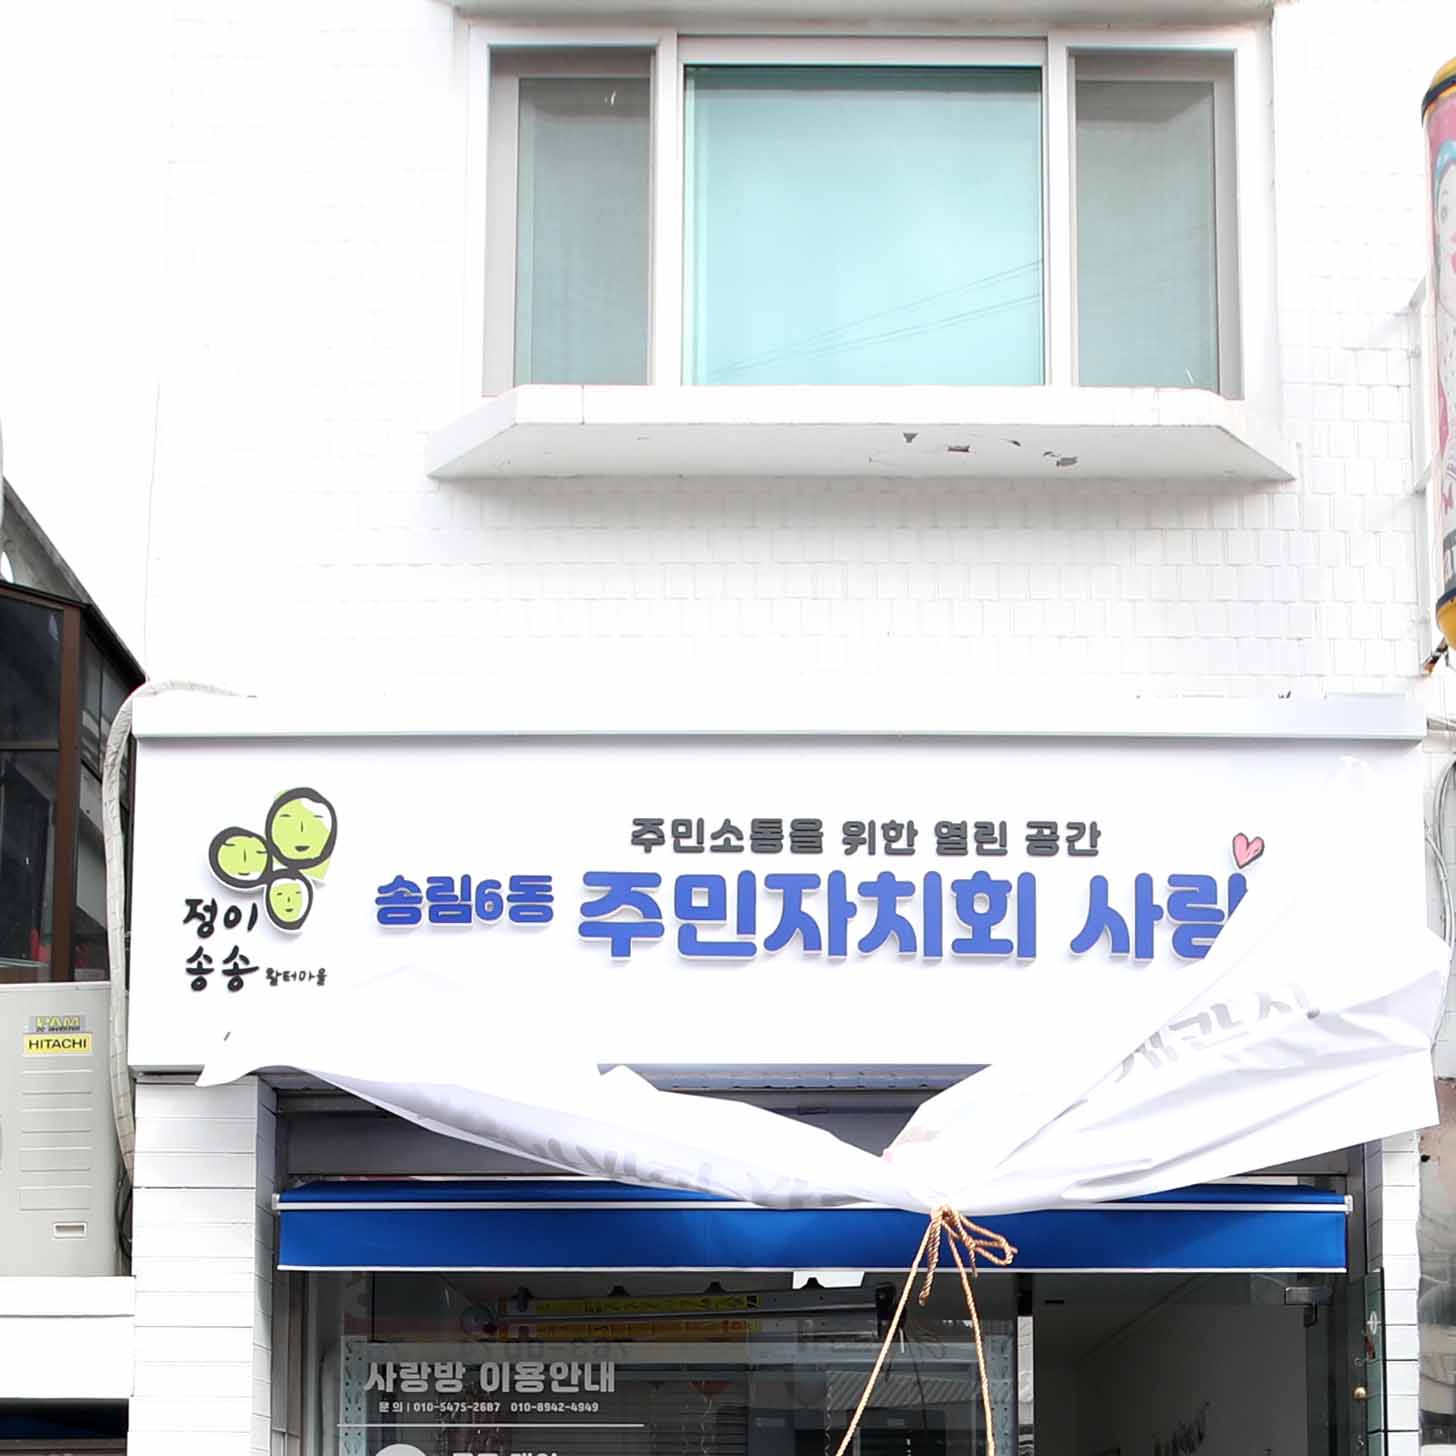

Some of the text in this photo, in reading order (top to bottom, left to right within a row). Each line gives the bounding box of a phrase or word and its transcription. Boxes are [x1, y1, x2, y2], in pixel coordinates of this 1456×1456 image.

[630, 817, 1102, 857] 주민소통을 위한 열린 공간
[183, 898, 258, 939] 정이
[375, 874, 554, 926] 송림6동
[578, 870, 1037, 959] 주민자치회
[185, 945, 260, 992] 송송
[28, 1038, 87, 1049] HITACHI
[364, 1361, 615, 1393] 사랑방 이용안내
